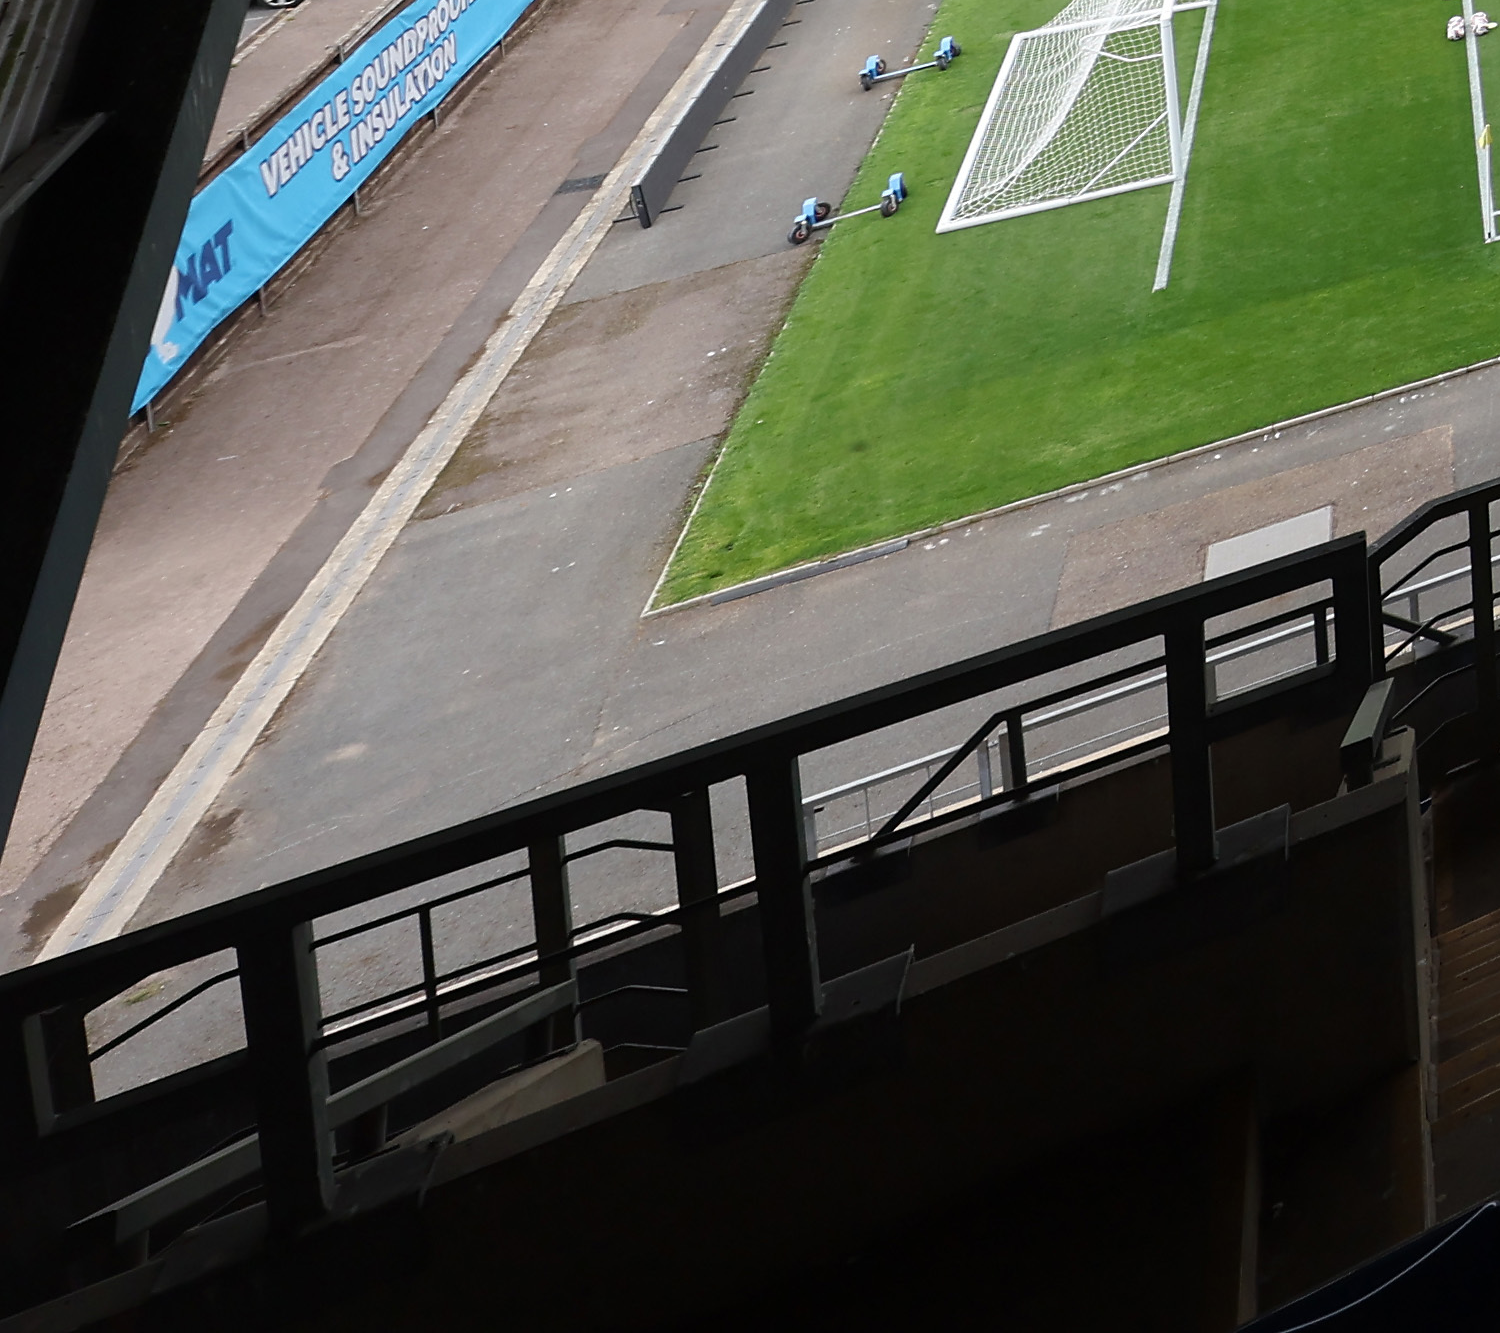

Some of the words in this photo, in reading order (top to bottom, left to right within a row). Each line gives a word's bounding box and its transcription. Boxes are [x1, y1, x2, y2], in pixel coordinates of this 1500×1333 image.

[259, 85, 351, 199] VEHICLE
[331, 140, 349, 181] &
[350, 30, 457, 167] INSULATION
[175, 219, 233, 322] MAT
